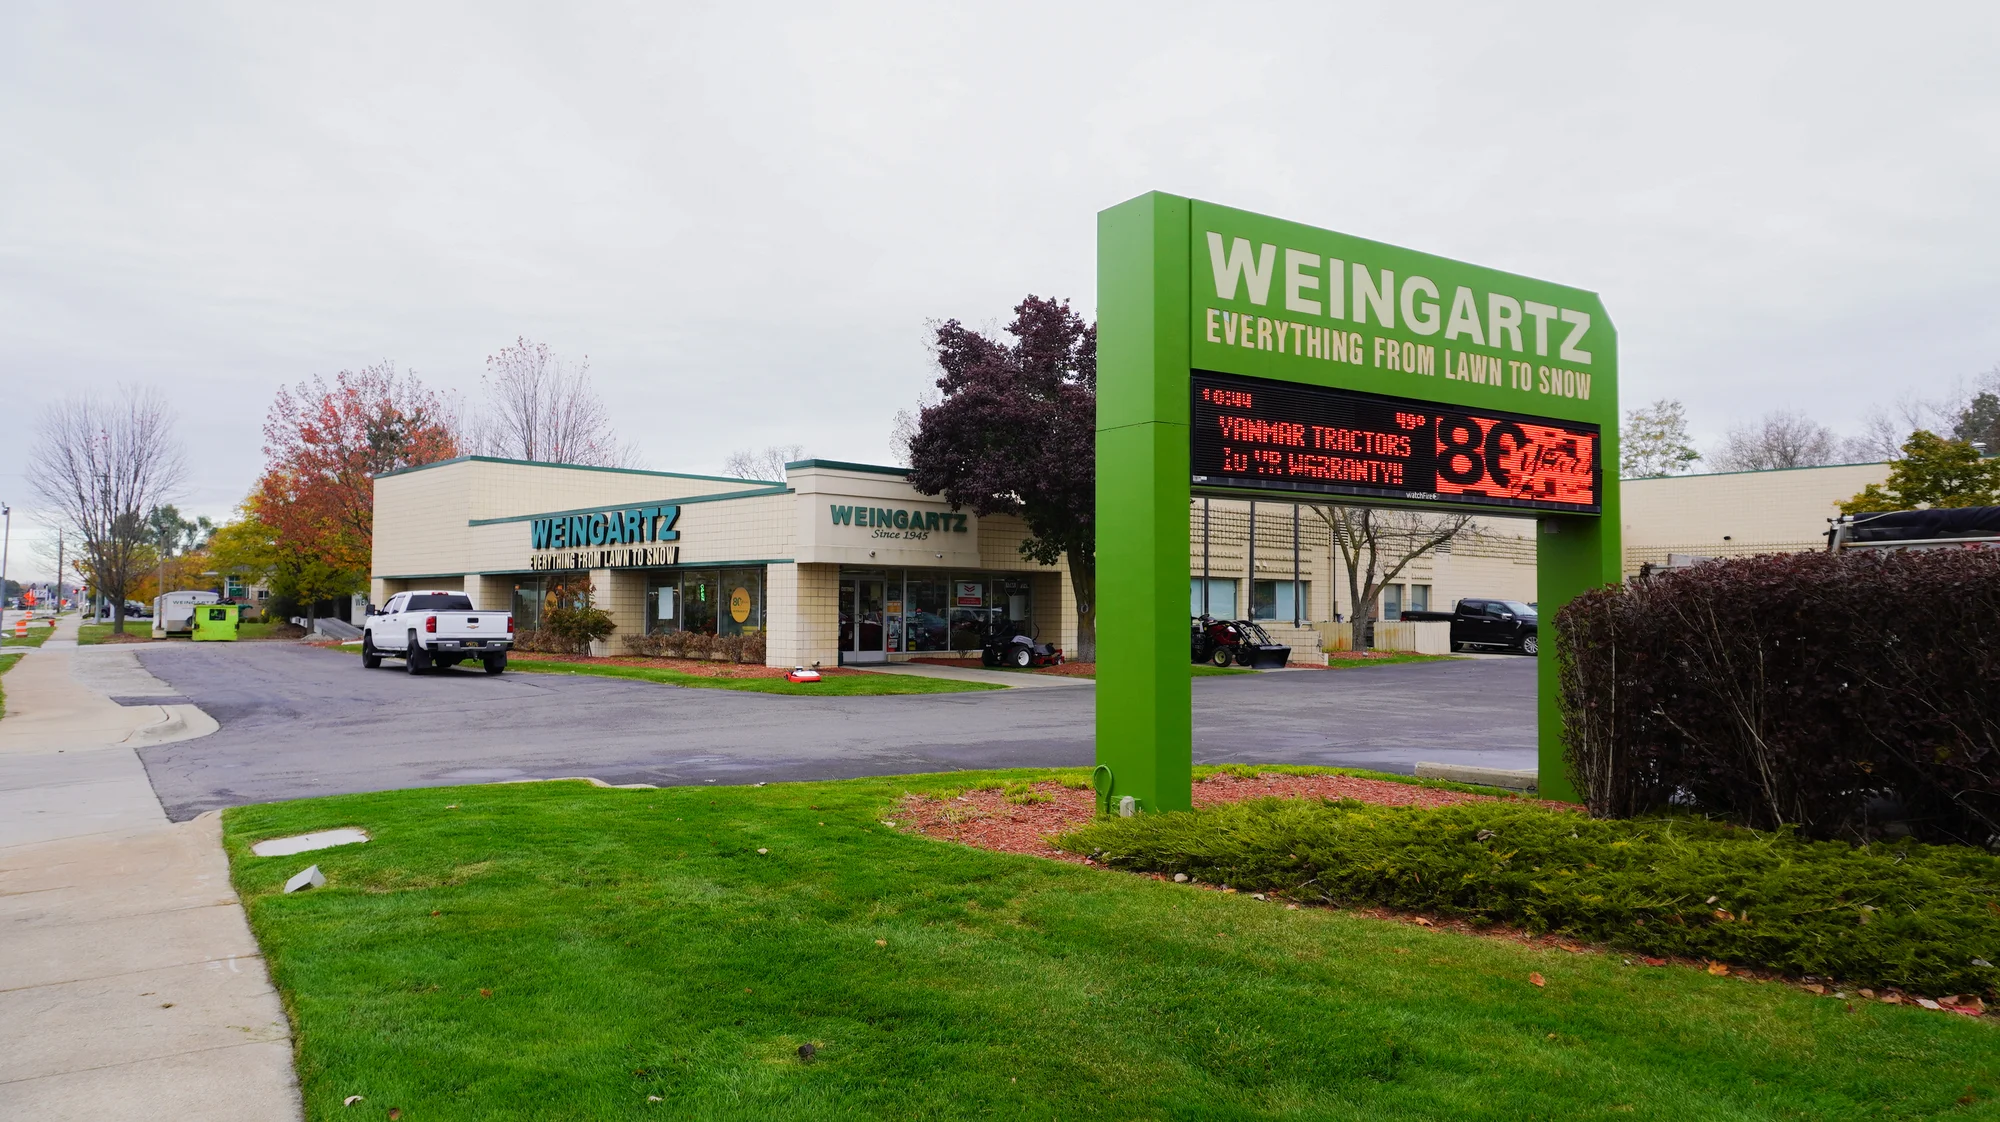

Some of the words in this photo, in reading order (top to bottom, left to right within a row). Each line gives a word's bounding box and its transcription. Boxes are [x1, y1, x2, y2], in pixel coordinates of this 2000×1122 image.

[1206, 231, 1592, 365] WEINGARTZ
[1206, 308, 1363, 365] EVERYTHING
[1374, 336, 1435, 377] FROM
[1445, 348, 1502, 387] LAWN
[1508, 360, 1532, 392] TO
[1539, 365, 1592, 401] SNOW
[1203, 388, 1252, 408] 10:44
[1219, 415, 1305, 447] YANMAR
[1312, 425, 1412, 457] TRACTORS
[530, 505, 681, 549] WEINGARTZ
[830, 504, 968, 533] WEINGARTZ
[871, 529, 901, 539] Since
[902, 531, 929, 540] 1945
[530, 552, 575, 570] EVERYTHING
[577, 551, 601, 568] FROM
[604, 549, 629, 567] LAWN
[632, 548, 644, 566] TO
[646, 546, 678, 566] SNOW
